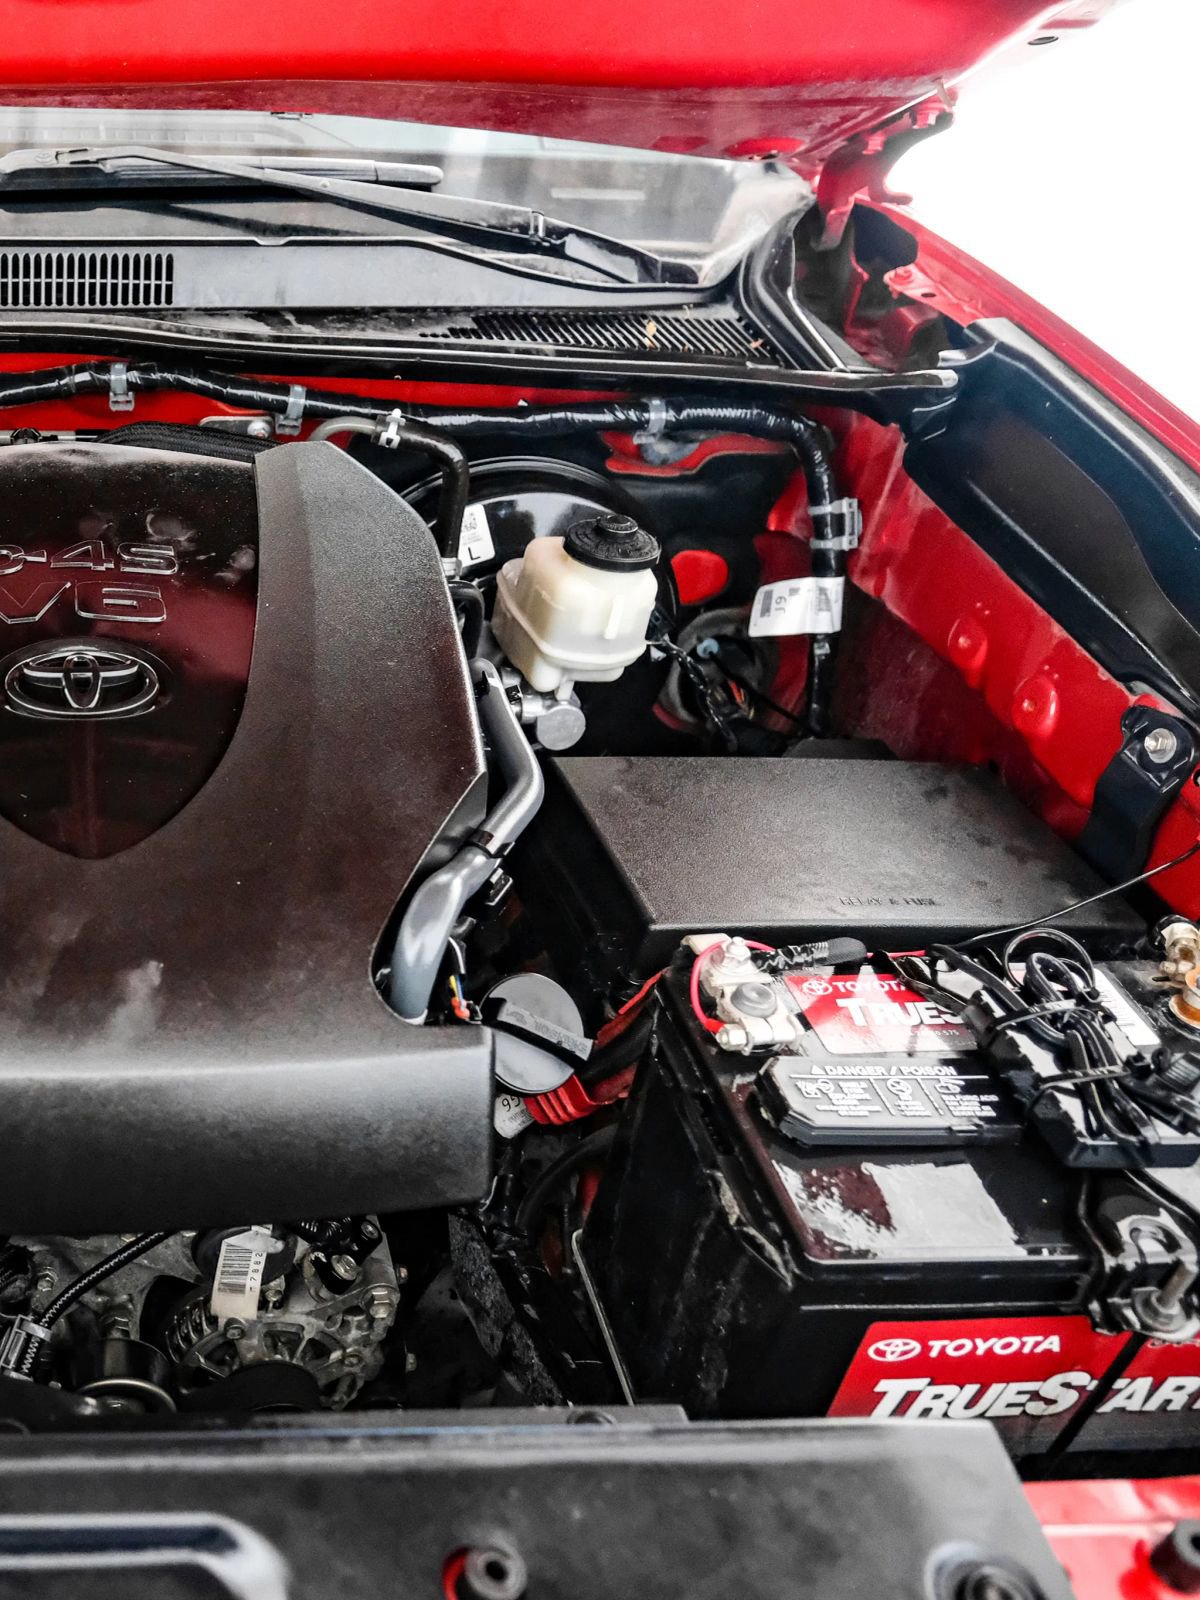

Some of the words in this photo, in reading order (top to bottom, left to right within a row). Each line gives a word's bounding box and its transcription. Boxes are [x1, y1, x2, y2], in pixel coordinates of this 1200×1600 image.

[468, 546, 481, 561] L
[825, 1065, 886, 1076] DANGER
[899, 1065, 958, 1076] POISON
[927, 1335, 1061, 1358] TOYOTA
[869, 1371, 1200, 1418] TRUESAR
